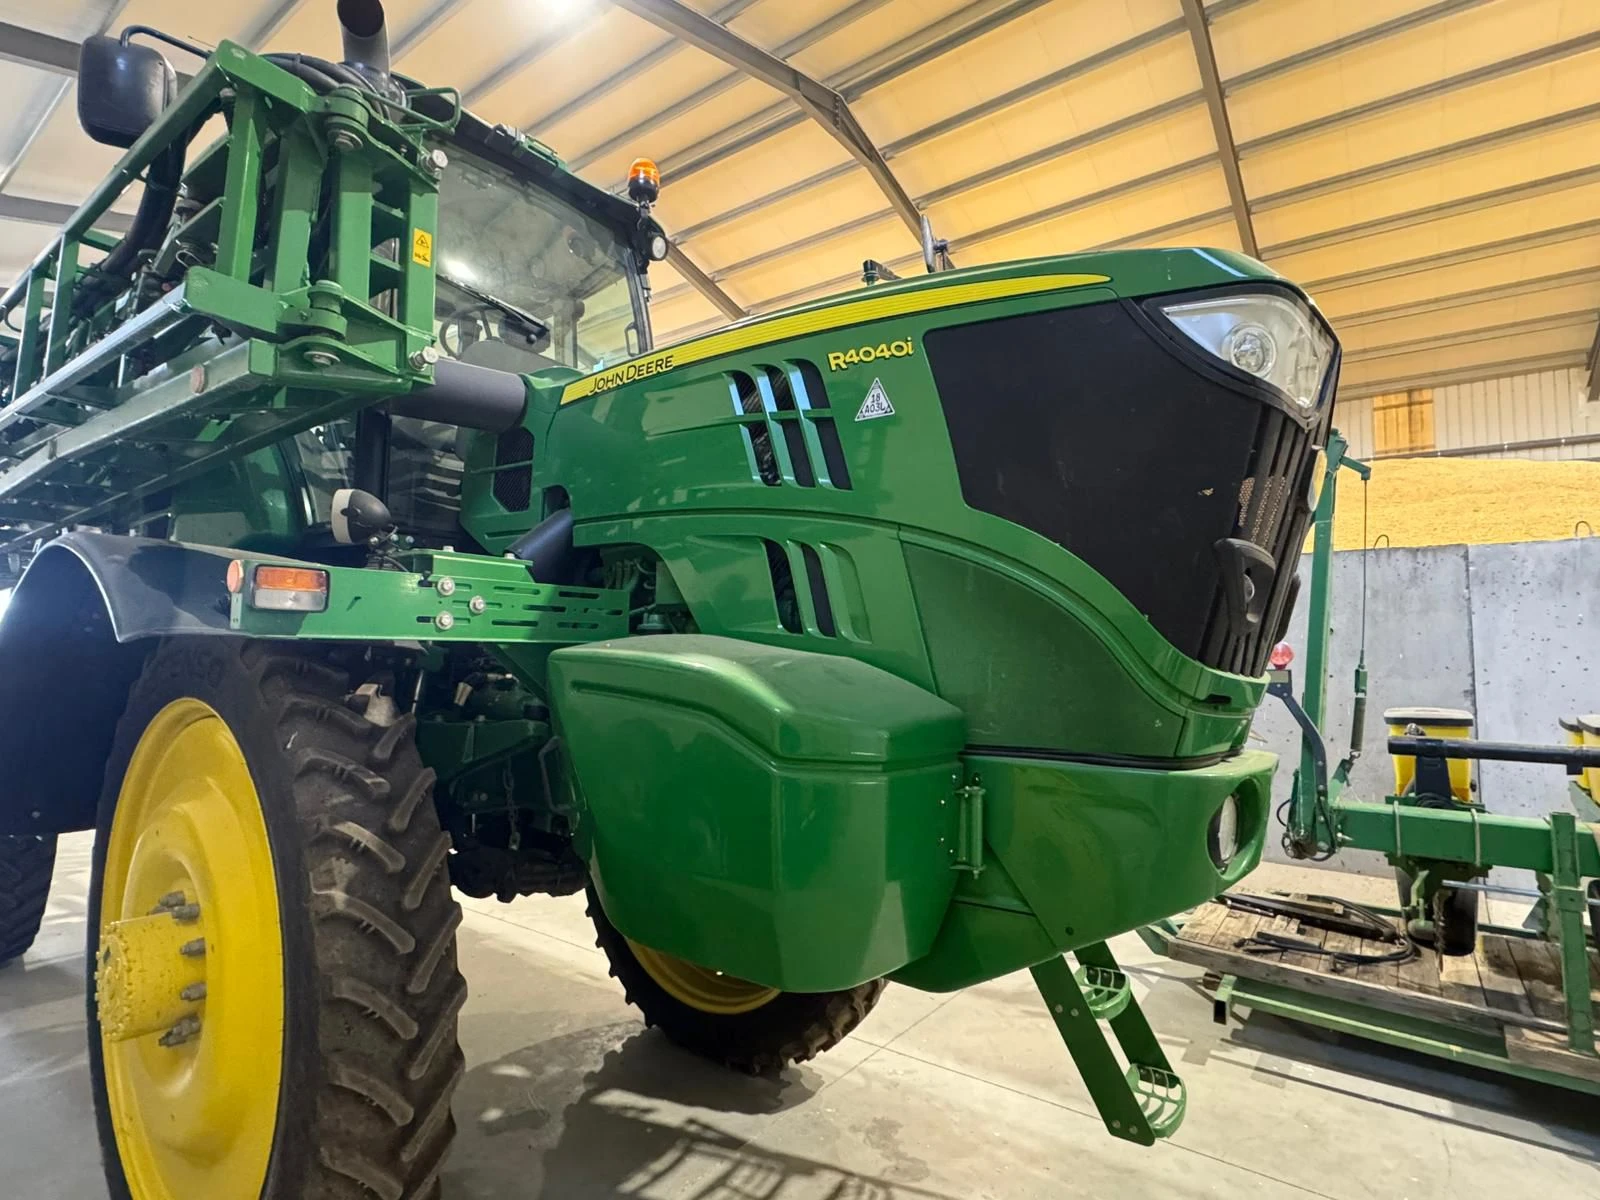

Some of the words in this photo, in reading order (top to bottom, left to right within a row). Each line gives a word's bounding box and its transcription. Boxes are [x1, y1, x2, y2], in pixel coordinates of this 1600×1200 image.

[828, 337, 914, 371] R4040i
[590, 371, 624, 393] JOHN
[626, 355, 673, 381] DEERE
